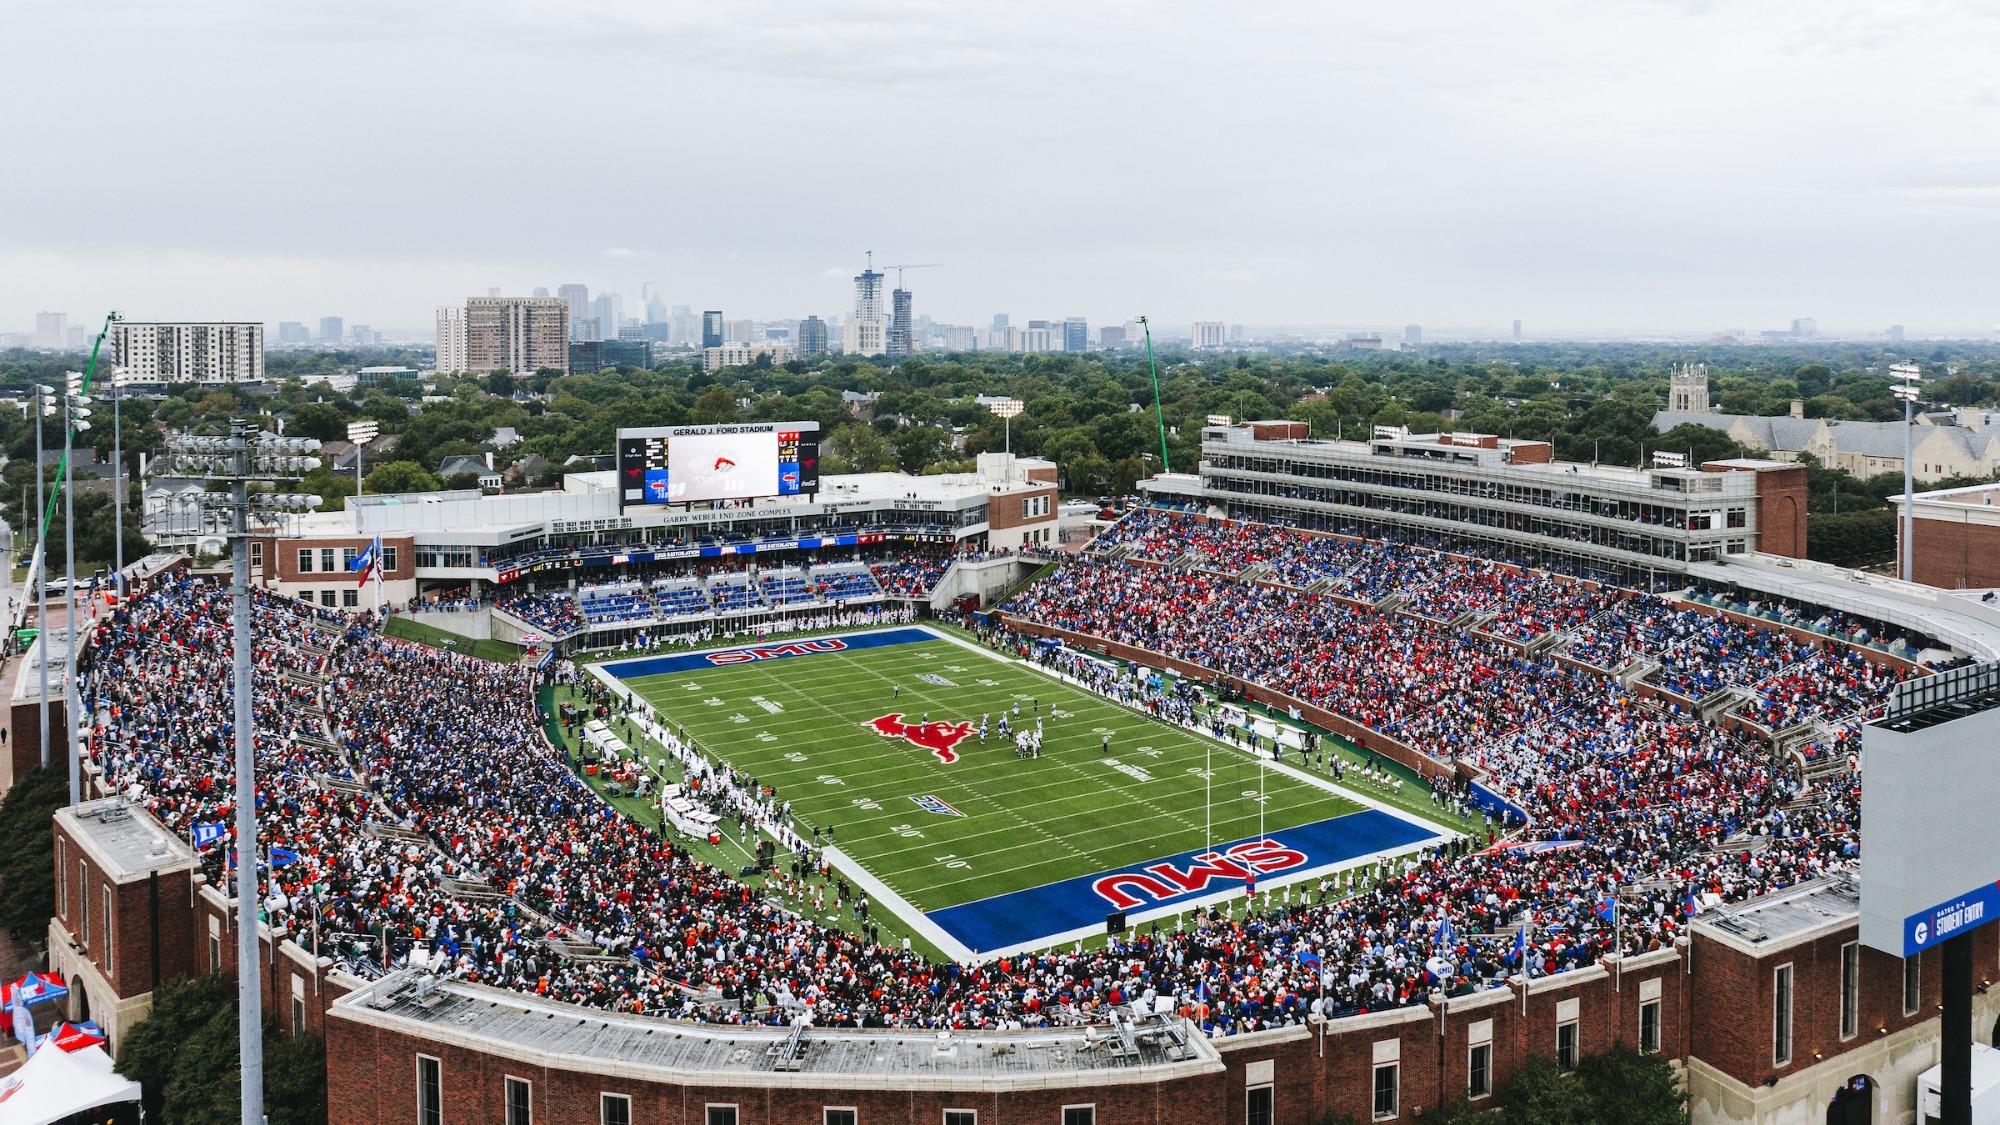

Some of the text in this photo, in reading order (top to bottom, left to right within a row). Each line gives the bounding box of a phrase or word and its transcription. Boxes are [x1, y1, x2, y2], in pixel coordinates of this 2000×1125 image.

[673, 428, 707, 436] GERALD
[716, 427, 738, 435] FORD
[739, 425, 774, 434] STADIUM
[664, 515, 689, 523] GARRY
[692, 513, 716, 521] WEBER
[736, 510, 756, 518] ZONE
[758, 507, 792, 517] COMPLEX
[706, 639, 848, 666] SMU
[852, 797, 880, 810] 30
[890, 824, 921, 838] 20
[934, 853, 968, 869] 10
[1092, 838, 1309, 911] SMU
[1936, 905, 1955, 918] GATES
[1936, 900, 1984, 937] STUDENT ENTRY
[1437, 966, 1453, 976] SMU
